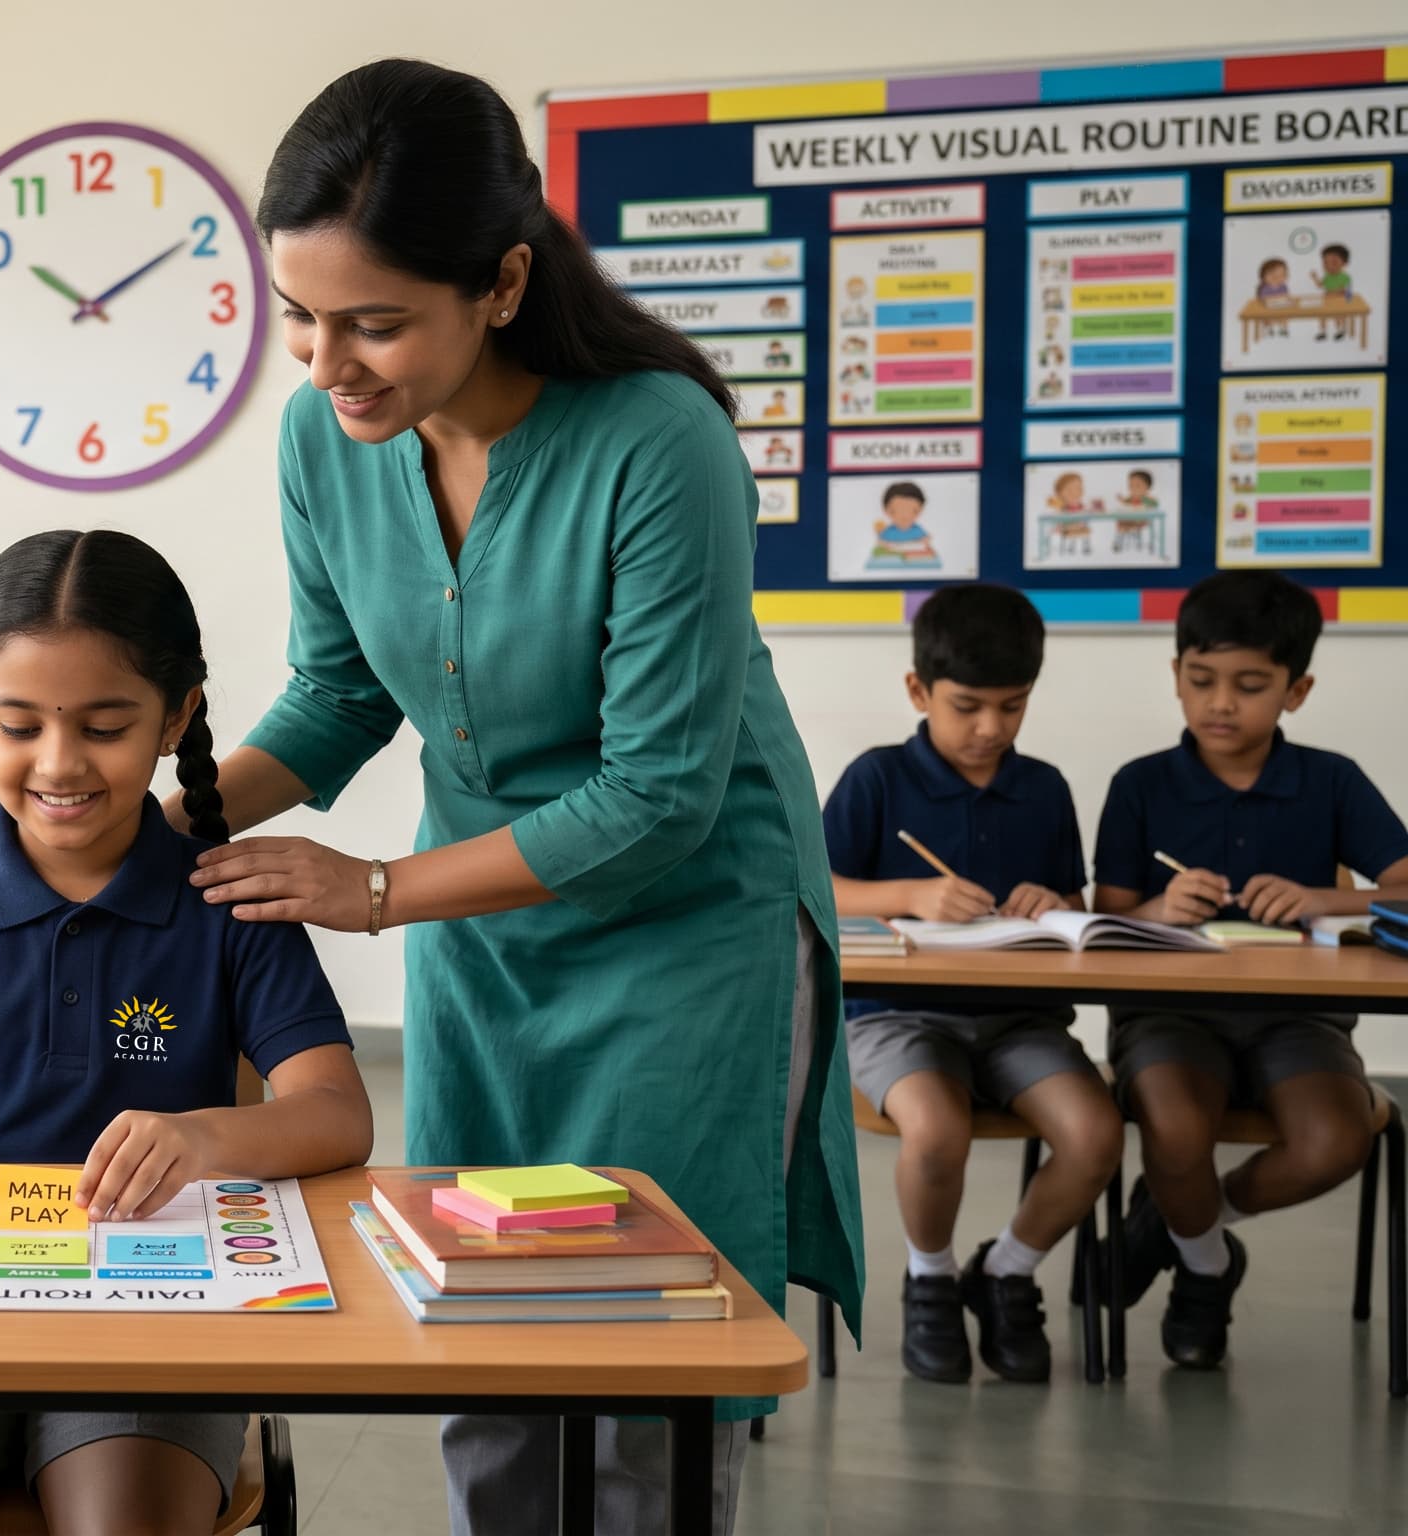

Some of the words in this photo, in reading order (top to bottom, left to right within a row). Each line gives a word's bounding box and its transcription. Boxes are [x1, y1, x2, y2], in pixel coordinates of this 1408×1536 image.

[769, 133, 920, 170] WEEKLY
[931, 124, 1069, 160] VISUAL
[1082, 113, 1261, 153] ROUTINE
[69, 150, 115, 193] 12
[147, 166, 164, 208] 1
[11, 176, 46, 217] 11
[860, 197, 953, 219] ACTIVITY
[1079, 187, 1133, 207] PLAY
[191, 215, 218, 257] 2
[646, 208, 741, 229] MONDAY
[629, 255, 743, 277] BREAKFAST
[209, 282, 237, 325] 3
[187, 352, 219, 393] 4
[17, 407, 42, 446] 7
[77, 421, 105, 463] 6
[142, 404, 170, 446] 5
[114, 1052, 169, 1063] ACADEMY
[116, 1033, 168, 1053] CGR
[8, 1181, 72, 1202] MATH
[10, 1206, 70, 1225] PLAY
[105, 1289, 206, 1300] DAILY
